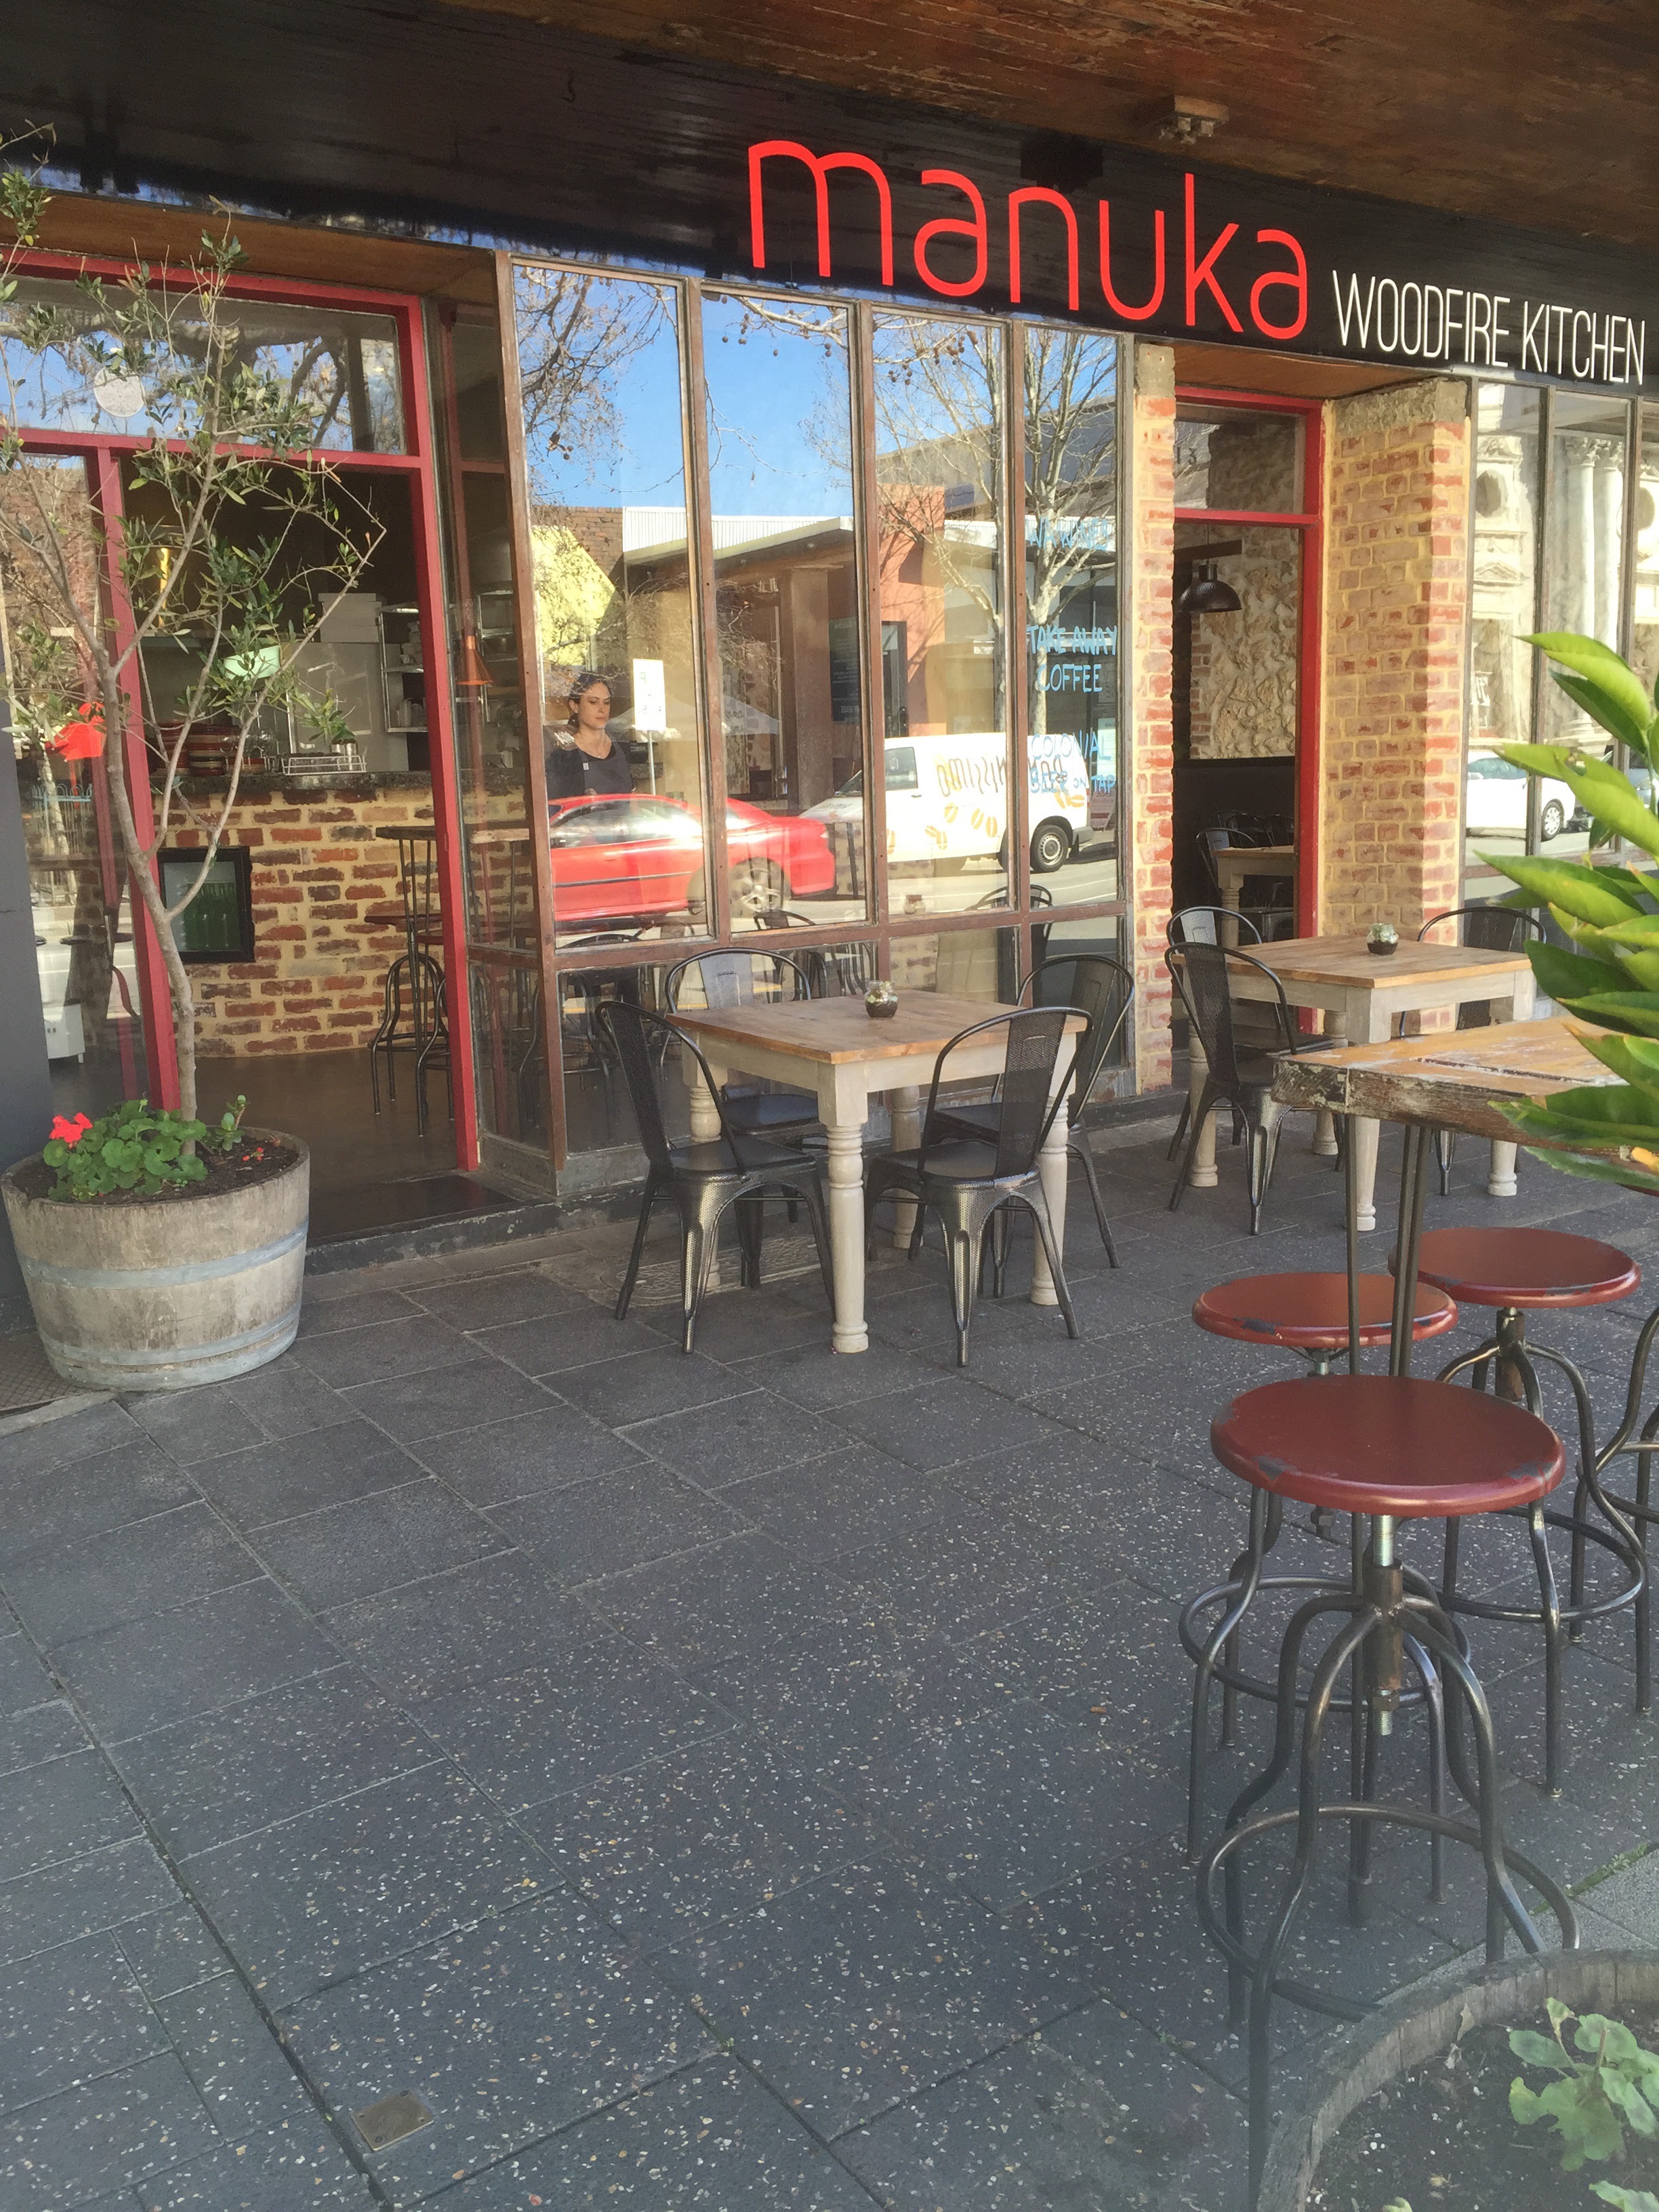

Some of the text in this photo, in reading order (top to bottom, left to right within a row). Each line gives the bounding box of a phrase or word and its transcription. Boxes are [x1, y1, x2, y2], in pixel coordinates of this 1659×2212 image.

[747, 140, 1307, 340] manuka
[1332, 270, 1645, 385] WOODFIRE KITCHEN
[1037, 663, 1103, 693] COFFEE
[1031, 729, 1111, 761] COLONIAL
[1029, 770, 1069, 795] BEER
[1090, 774, 1117, 794] TAP
